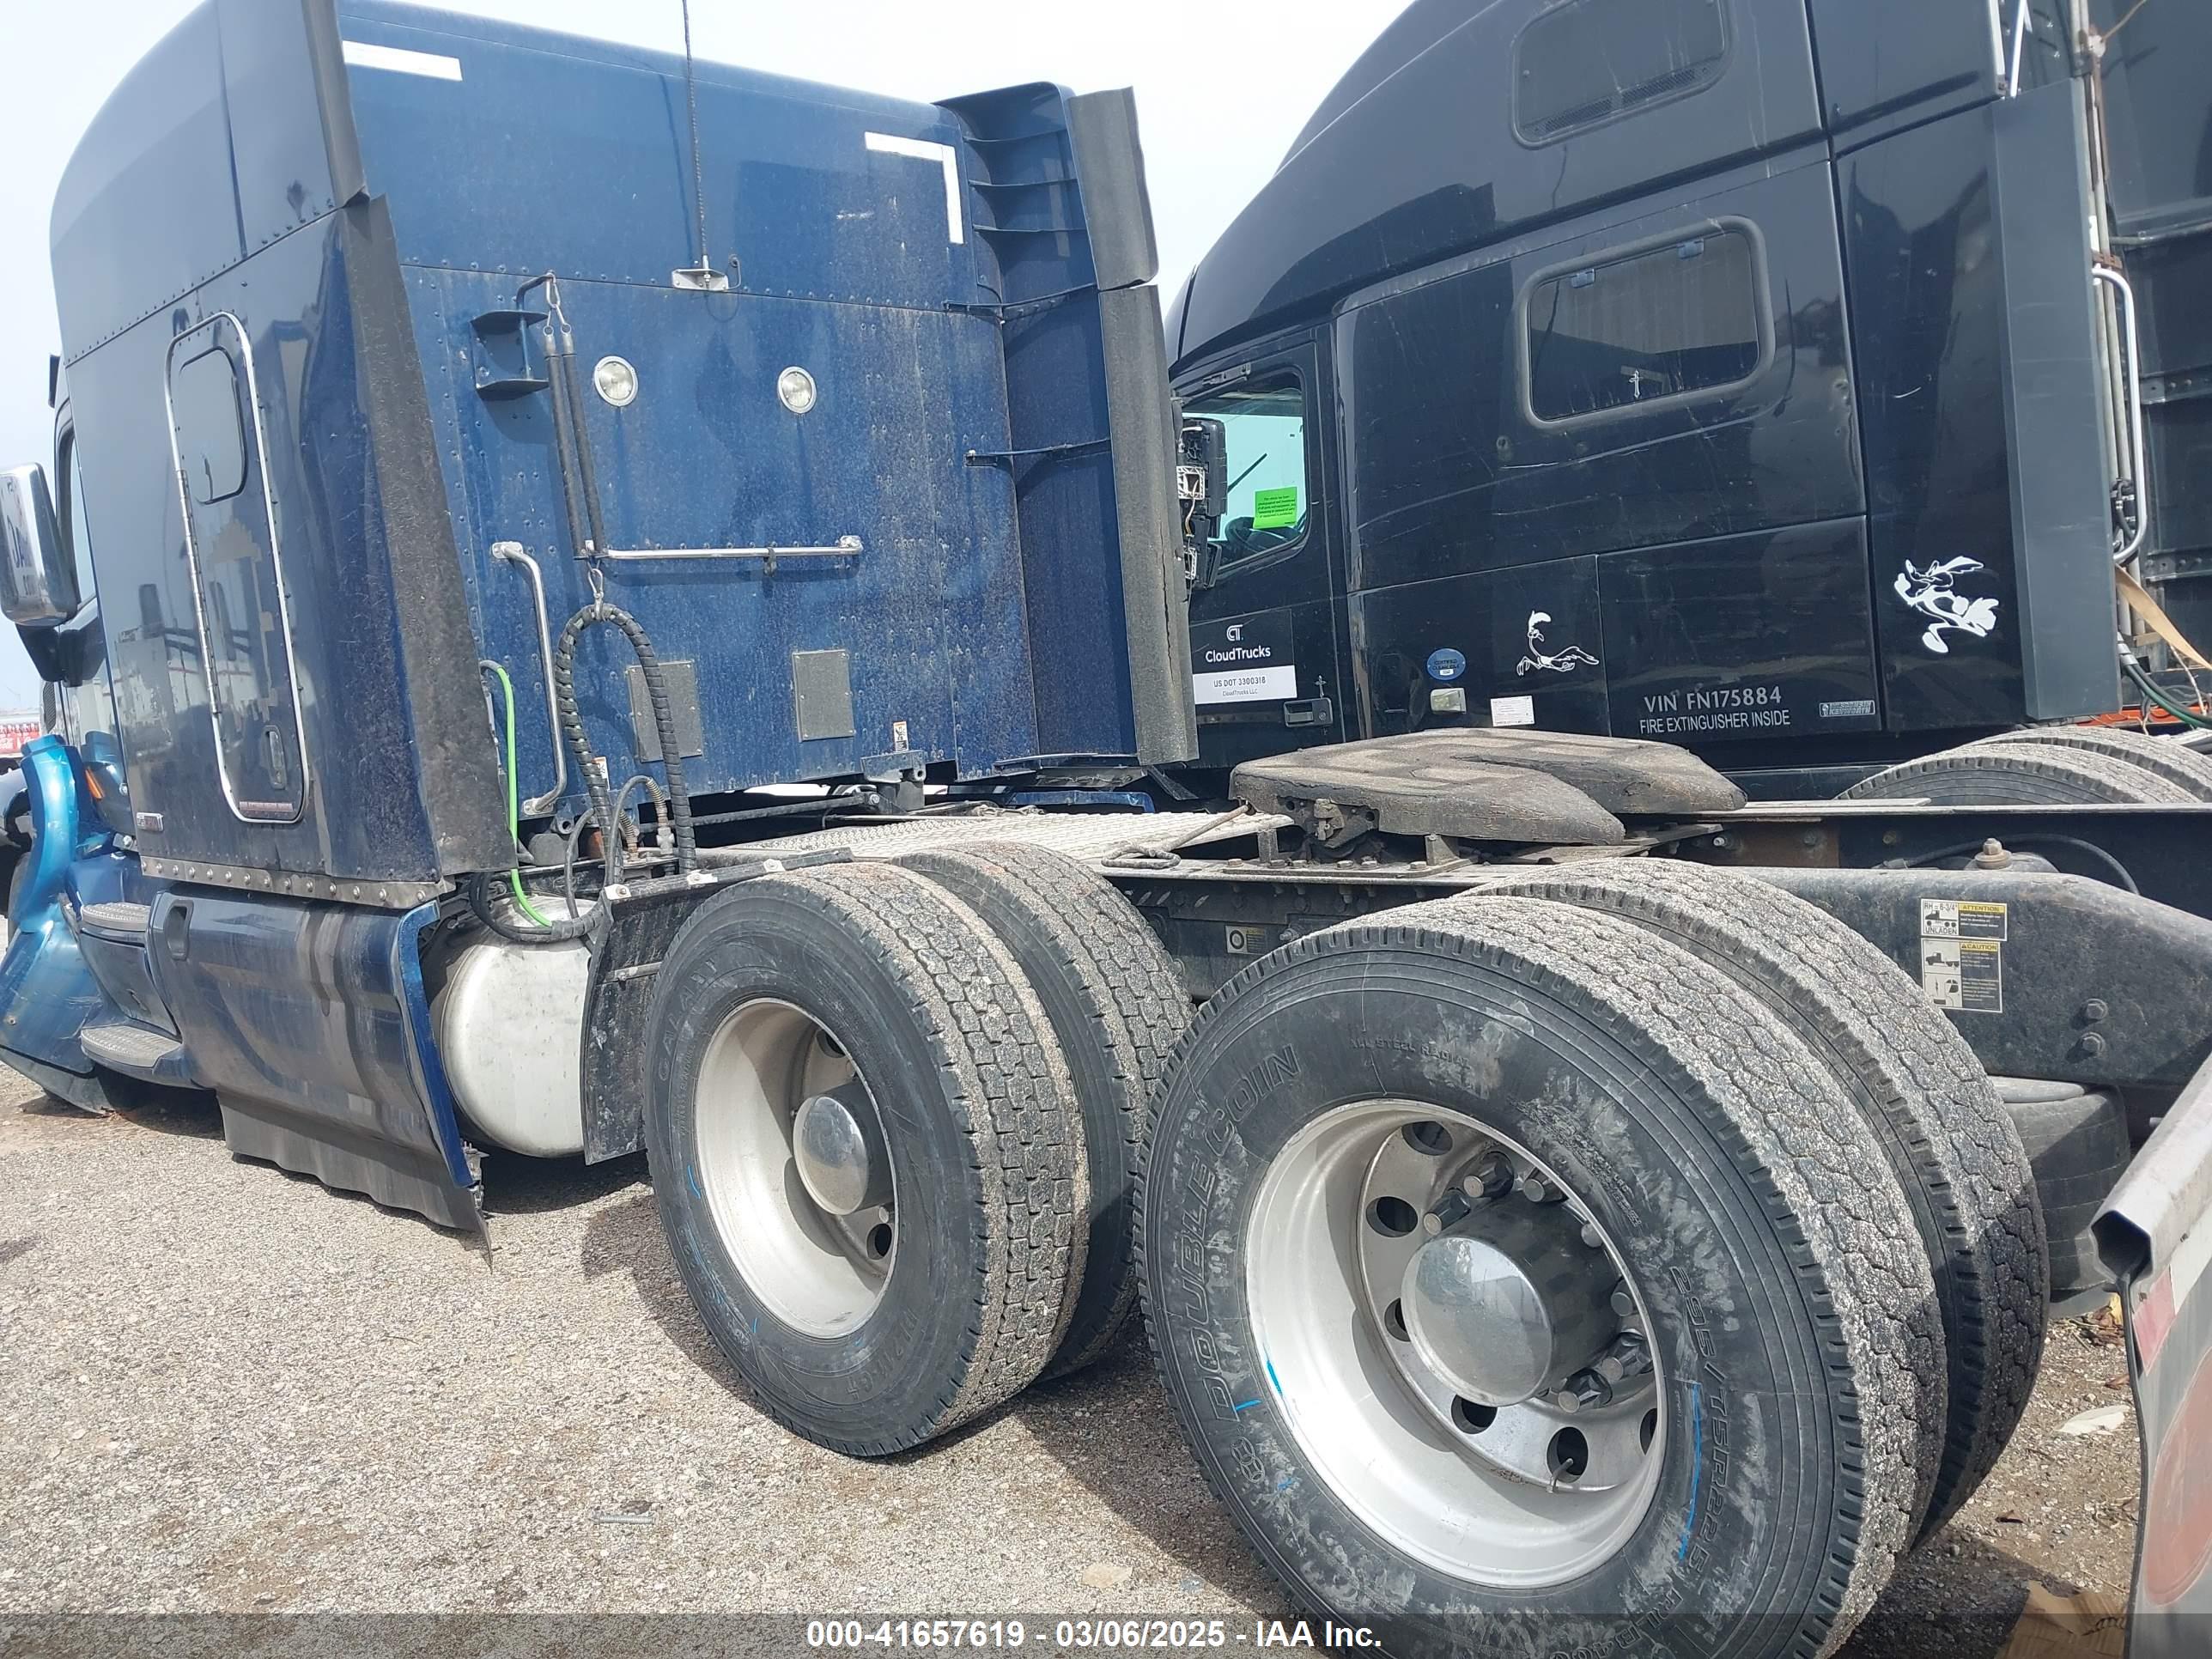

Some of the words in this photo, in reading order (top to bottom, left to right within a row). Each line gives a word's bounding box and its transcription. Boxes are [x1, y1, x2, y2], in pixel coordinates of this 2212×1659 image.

[1205, 645, 1272, 663] CloudTrucks
[1224, 678, 1237, 687] DOT
[1238, 676, 1266, 686] 3300318
[1644, 694, 1678, 713] VIN
[1686, 686, 1782, 710] FN175884
[1639, 718, 1665, 734] FIRE
[1666, 712, 1750, 732] EXTINGUISHER
[1751, 709, 1791, 727] INSIDE
[1924, 902, 1933, 910] RH
[1925, 927, 1958, 935] UNLADEN
[1205, 1044, 1300, 1158] COIN
[1182, 1158, 1242, 1422] DOUBLE
